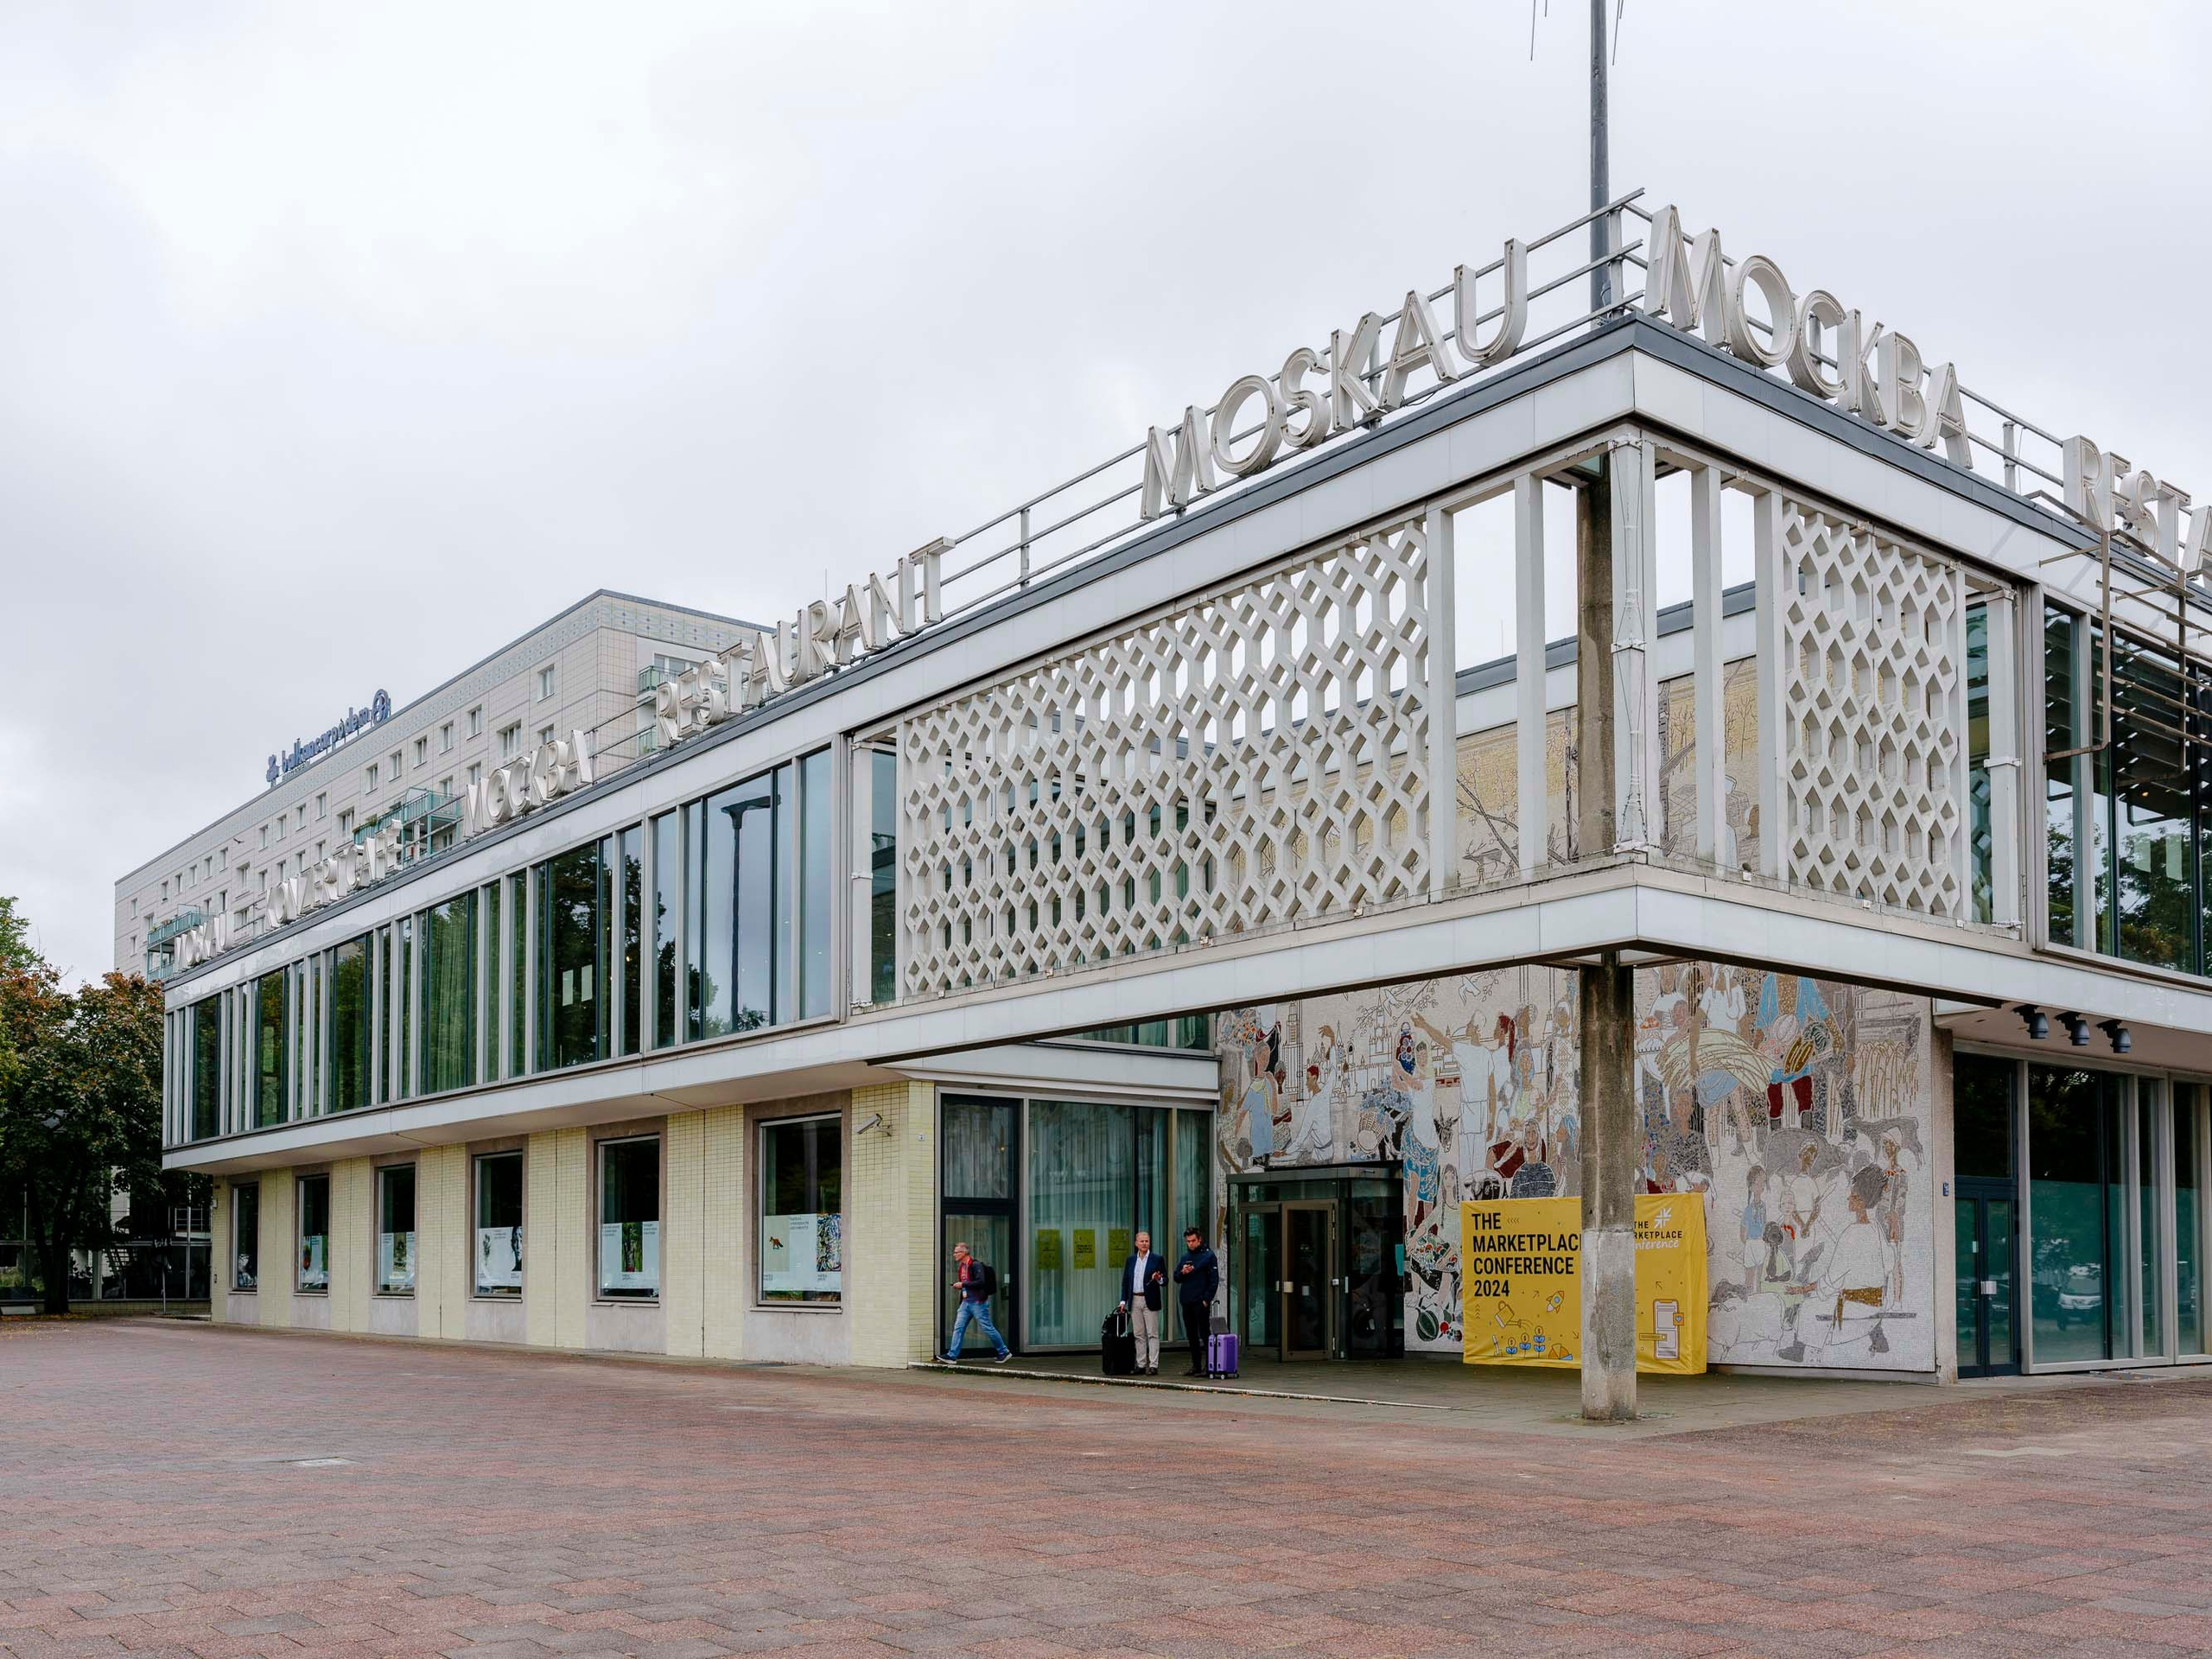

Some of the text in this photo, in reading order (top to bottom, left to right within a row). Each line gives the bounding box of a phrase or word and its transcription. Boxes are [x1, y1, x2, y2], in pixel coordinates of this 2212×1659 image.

[1141, 238, 1527, 519] MOSKAU
[657, 537, 956, 747] RESTAURANT
[1471, 1212, 1502, 1230] THE
[1633, 1230, 1682, 1239] RKETPLACE
[1473, 1257, 1574, 1274] CONFERENCE
[1474, 1280, 1510, 1297] 2024
